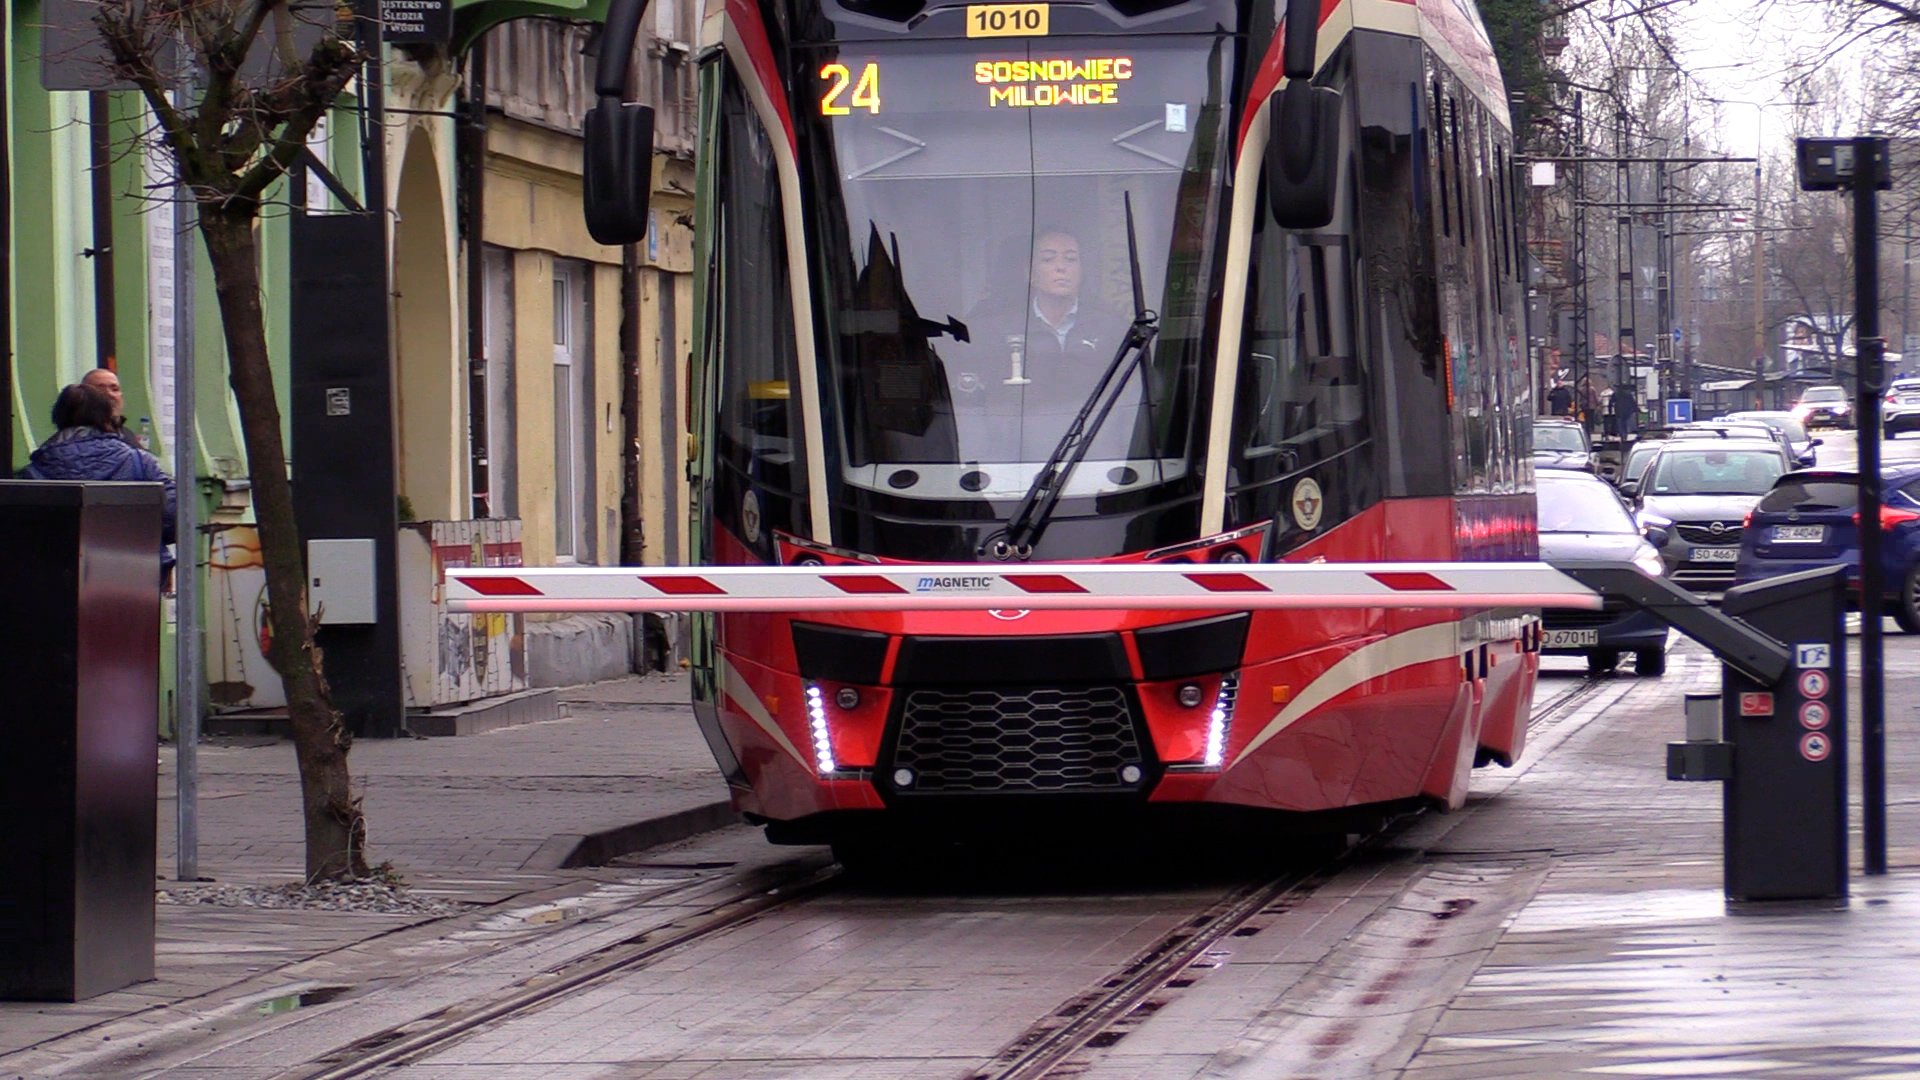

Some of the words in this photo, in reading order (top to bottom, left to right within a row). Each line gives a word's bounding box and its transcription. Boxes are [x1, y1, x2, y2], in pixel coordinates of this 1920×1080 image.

[975, 8, 1041, 31] 1010
[975, 58, 1132, 83] SOSNOWIEC
[820, 63, 880, 116] 24
[990, 82, 1118, 107] MILOWICE
[1674, 404, 1686, 420] L
[1555, 631, 1598, 644] 6701H
